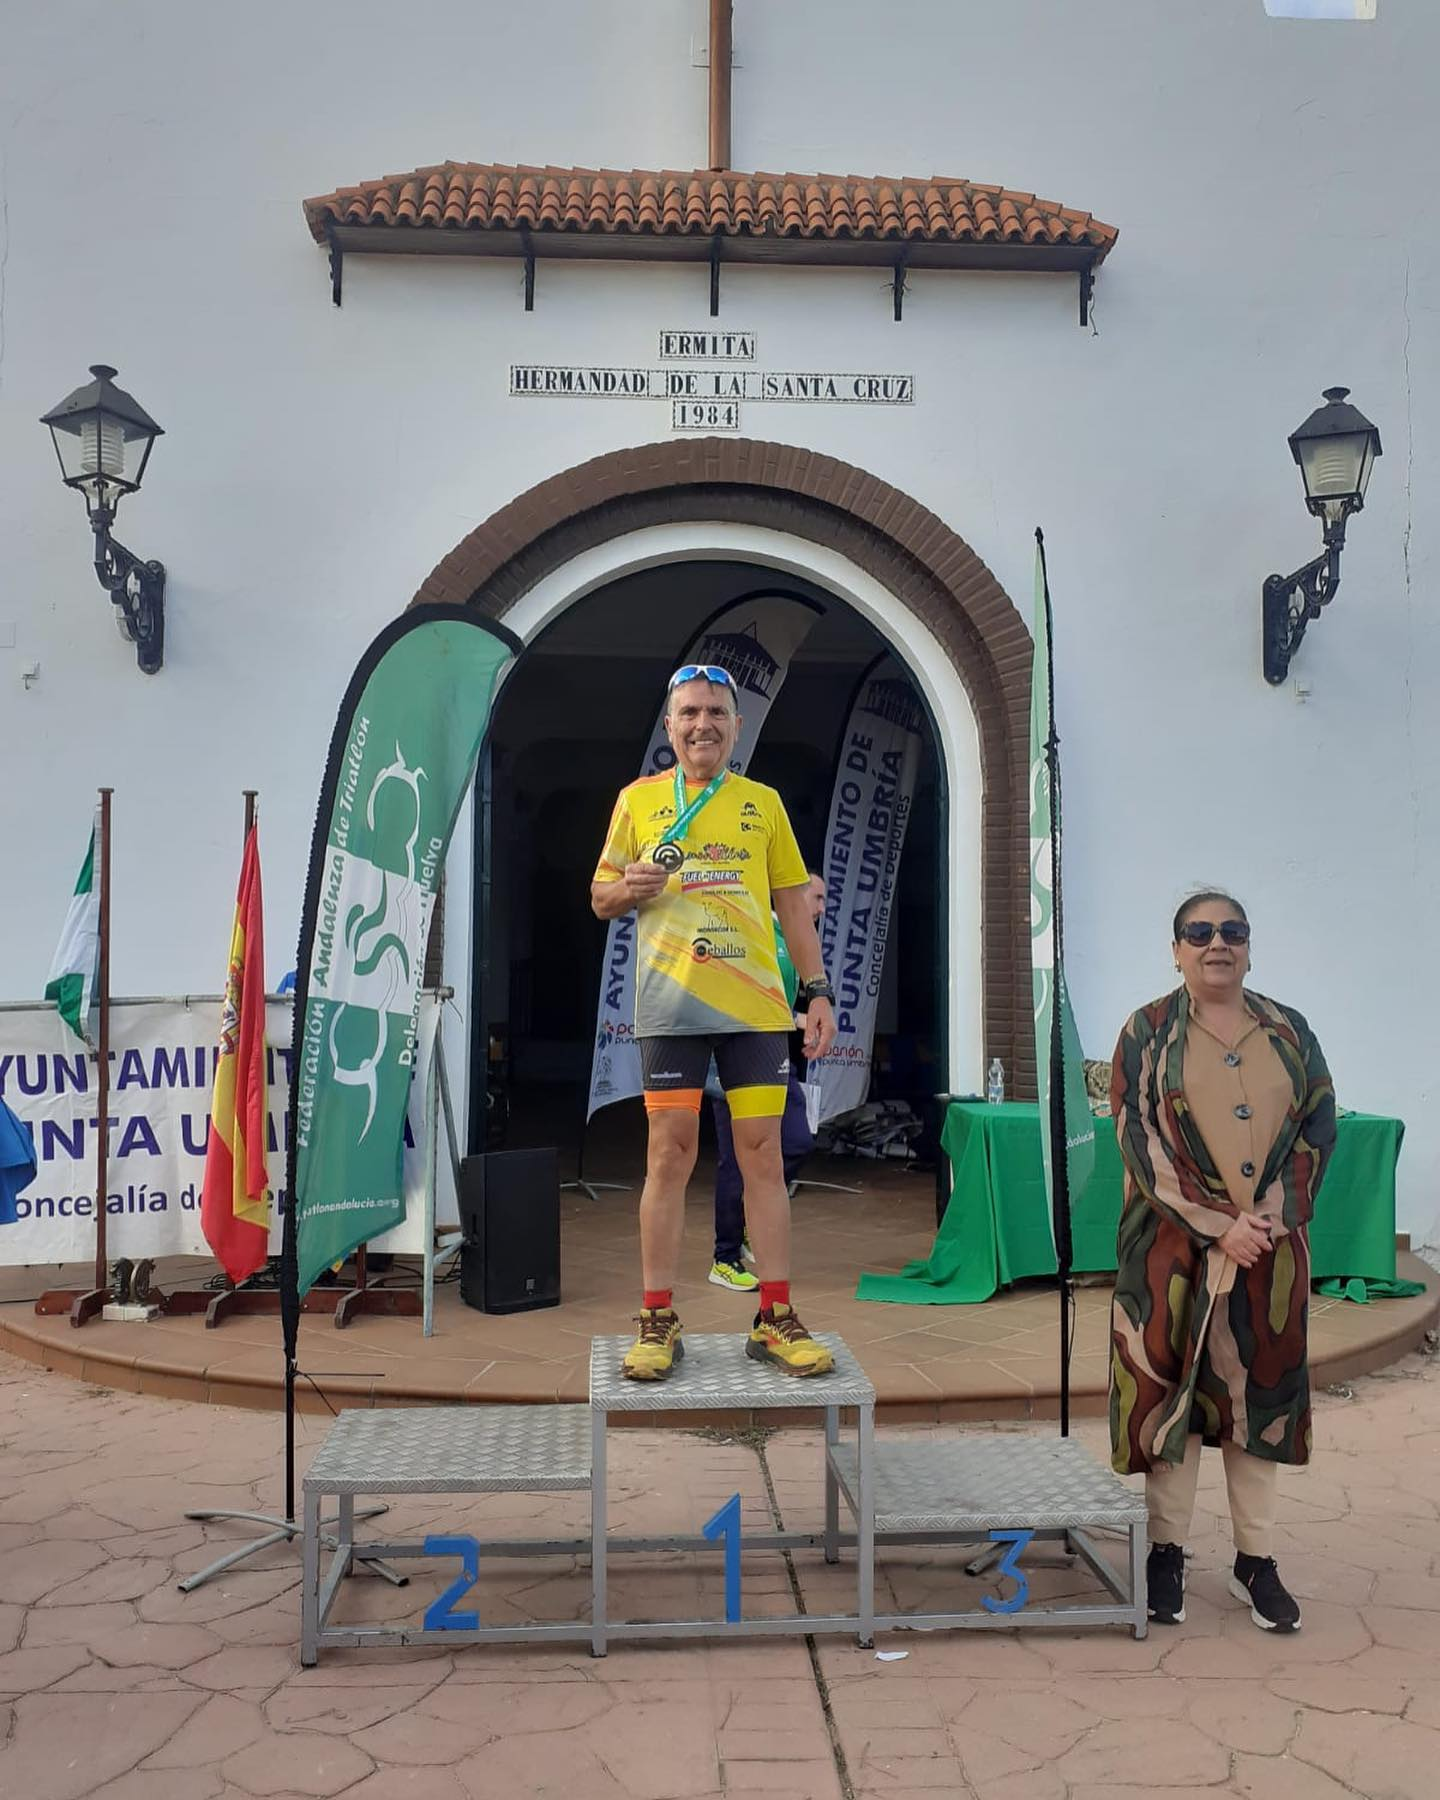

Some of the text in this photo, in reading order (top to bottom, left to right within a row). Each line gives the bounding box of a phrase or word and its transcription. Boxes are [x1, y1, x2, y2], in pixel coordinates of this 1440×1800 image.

[514, 369, 910, 400] HERMANDAD DE LA SANTA CRUZ
[664, 335, 749, 357] ERMITA
[679, 404, 735, 425] 1984
[339, 716, 371, 813] Triatlón
[846, 732, 873, 774] DE
[330, 819, 349, 850] de
[312, 854, 345, 988] Andaluza
[838, 751, 903, 1034] PUNTA UMBRÍA
[867, 795, 910, 997] Concejalía de Deportes
[423, 1534, 480, 1631] 2
[703, 1492, 741, 1624] 1
[981, 1529, 1034, 1613] 3
